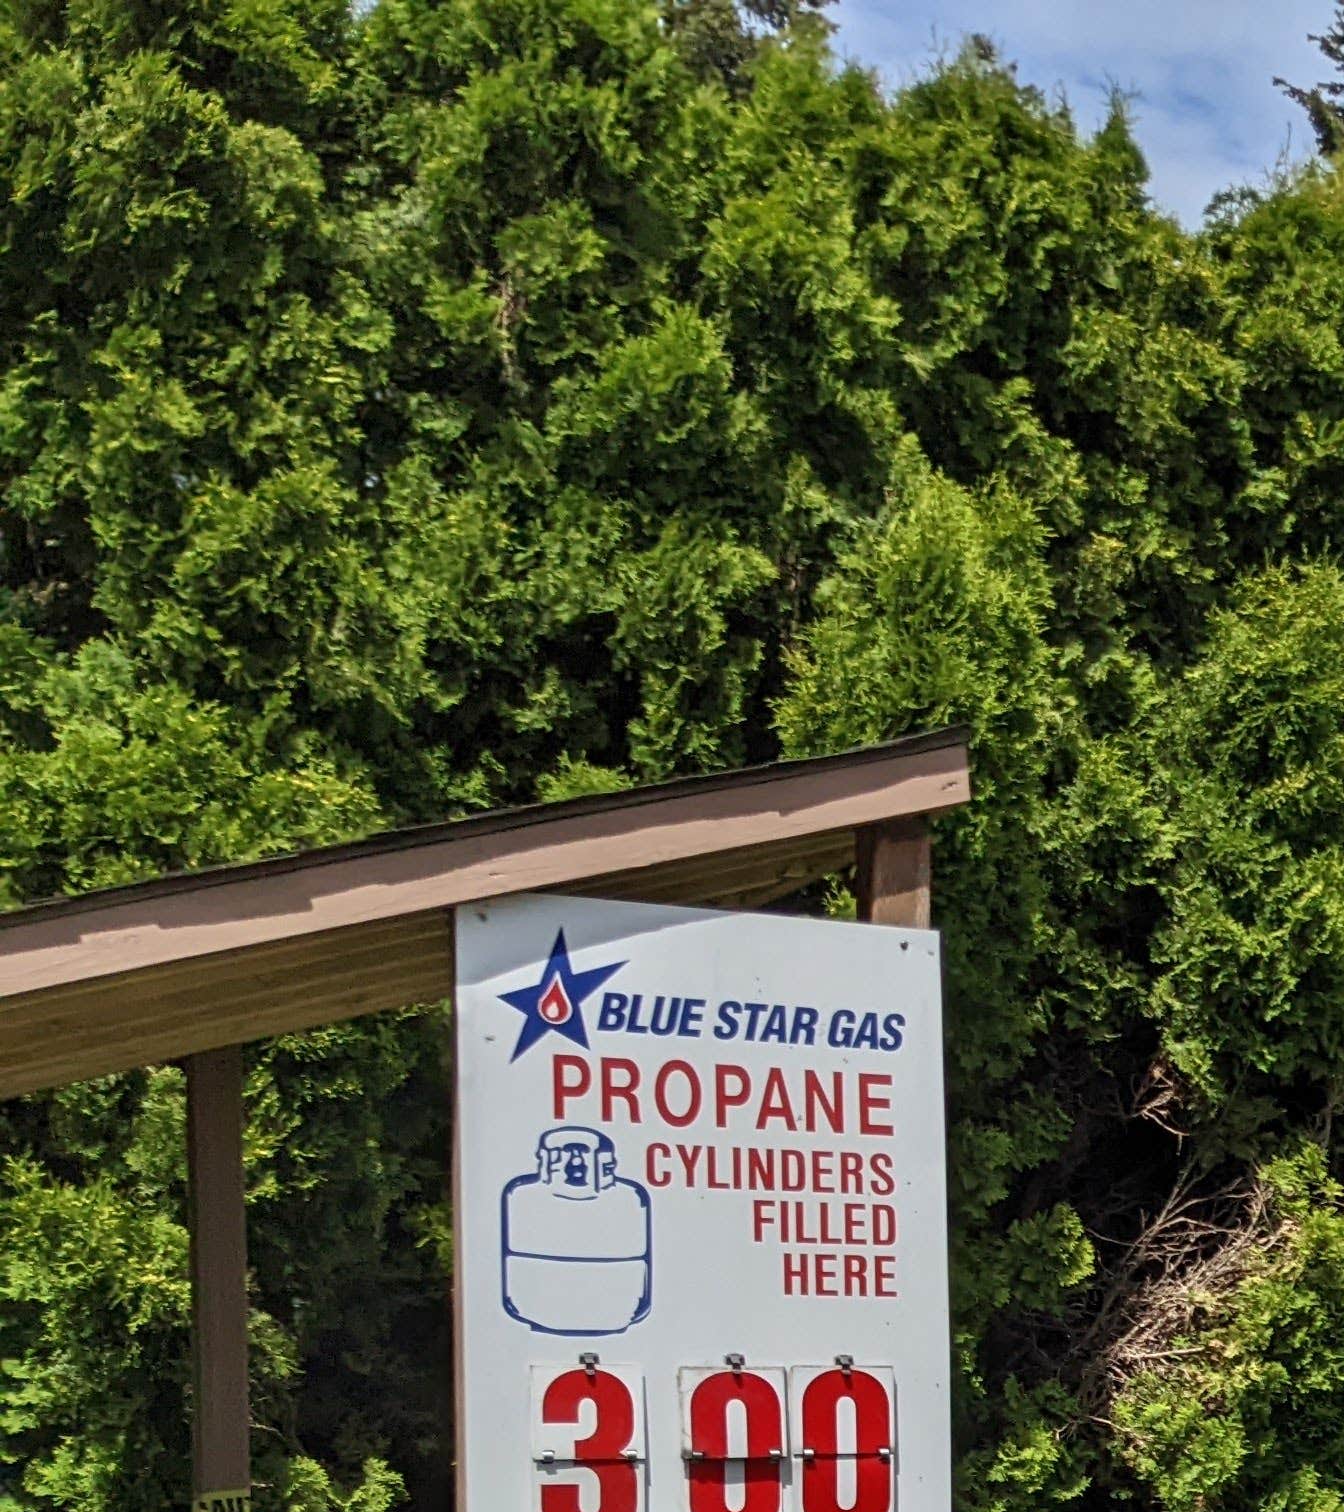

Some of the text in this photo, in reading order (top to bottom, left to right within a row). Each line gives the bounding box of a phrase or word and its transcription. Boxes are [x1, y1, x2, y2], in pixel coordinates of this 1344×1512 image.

[596, 992, 906, 1052] BLUE STAR GAS
[552, 1053, 895, 1137] PROPANE
[645, 1141, 896, 1196] CYLINDERS
[752, 1199, 897, 1246] FILLED
[782, 1252, 898, 1298] HERE
